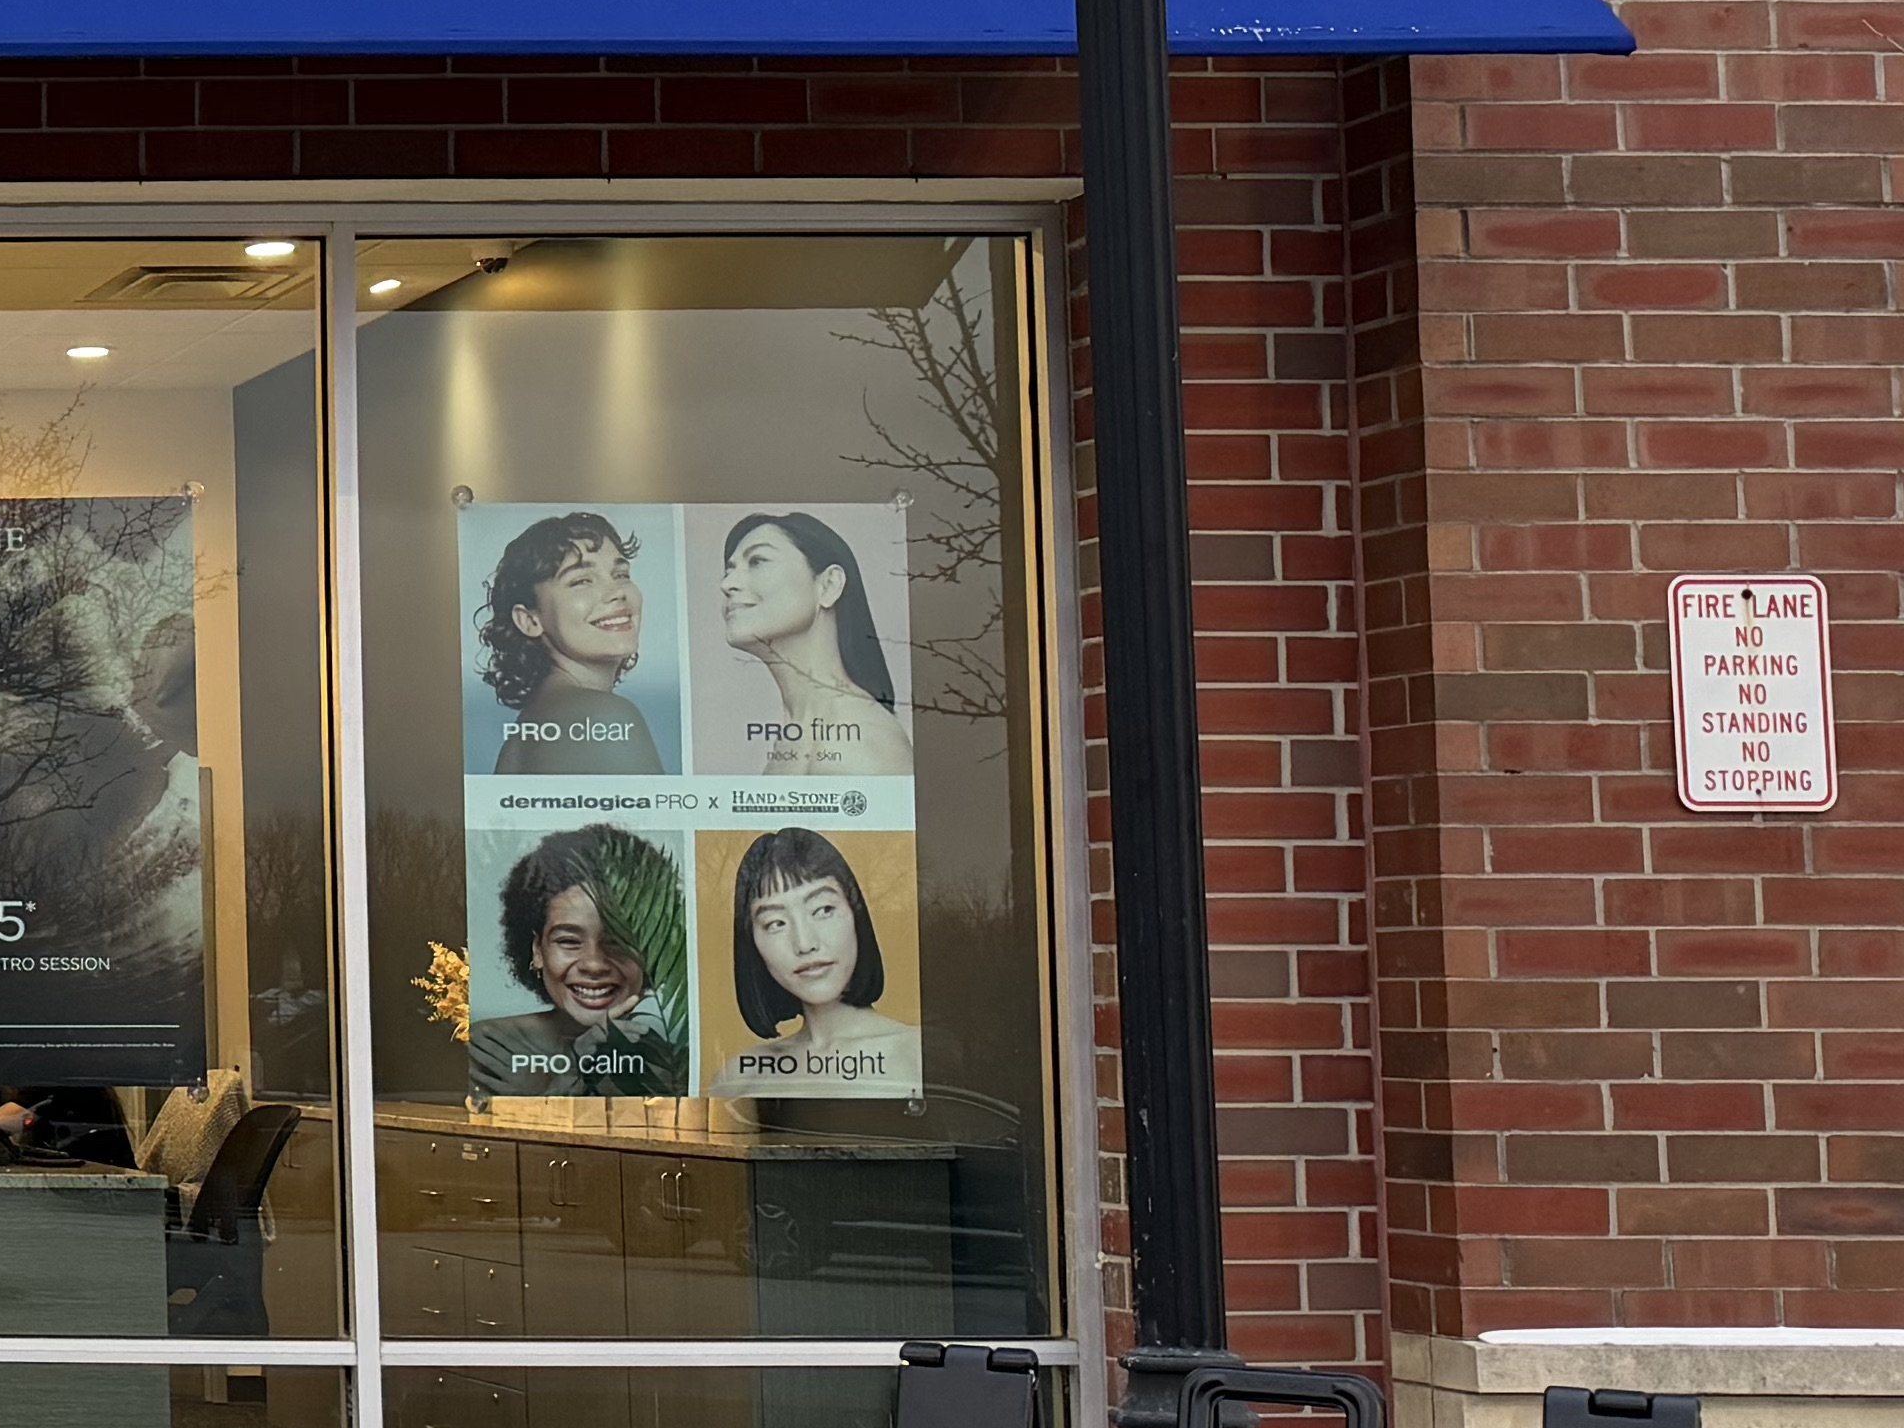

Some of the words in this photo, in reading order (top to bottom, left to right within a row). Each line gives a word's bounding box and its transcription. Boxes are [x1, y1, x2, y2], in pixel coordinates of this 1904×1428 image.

[1682, 594, 1736, 619] FIRE
[1752, 594, 1814, 619] LANE
[1735, 626, 1763, 647] NO
[1704, 655, 1799, 677] PARKING
[1739, 683, 1767, 705] NO
[503, 722, 561, 741] PRO
[569, 719, 634, 742] clear
[747, 723, 803, 741] PRO
[811, 719, 861, 741] firm
[1701, 712, 1808, 734] STANDING
[766, 749, 798, 761] neck
[816, 749, 842, 761] skin
[1742, 741, 1770, 762] NO
[1704, 770, 1812, 791] STOPPING
[499, 794, 651, 812] dermalogica
[655, 794, 698, 810] PRO
[732, 790, 777, 804] HAND
[788, 791, 839, 804] STONE
[39, 957, 111, 972] SESSION
[511, 1054, 571, 1073] PRO
[578, 1050, 644, 1074] calm
[739, 1054, 798, 1074] PRO
[806, 1050, 886, 1080] bright
